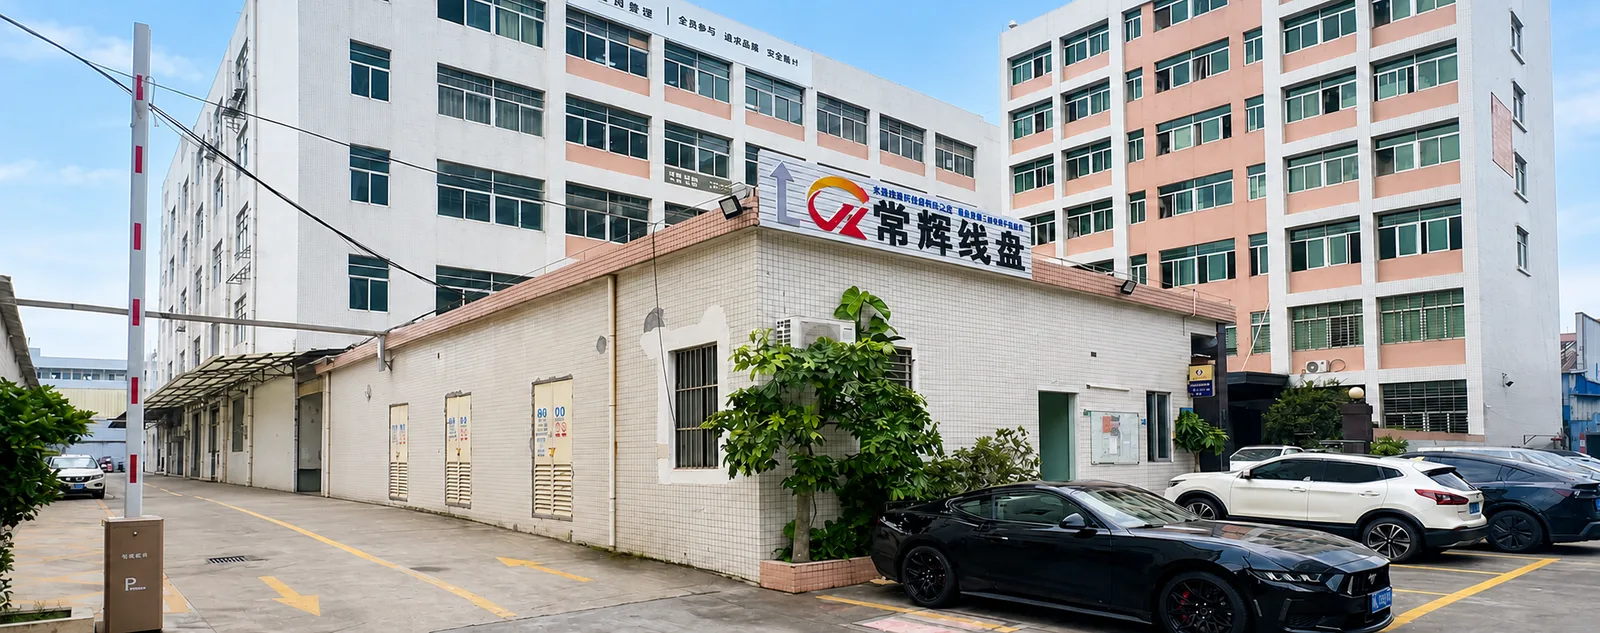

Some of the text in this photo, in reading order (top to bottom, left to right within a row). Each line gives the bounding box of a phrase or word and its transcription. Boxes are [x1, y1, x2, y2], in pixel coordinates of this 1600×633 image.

[873, 199, 1026, 271] 常辉线盘
[125, 577, 136, 592] P
